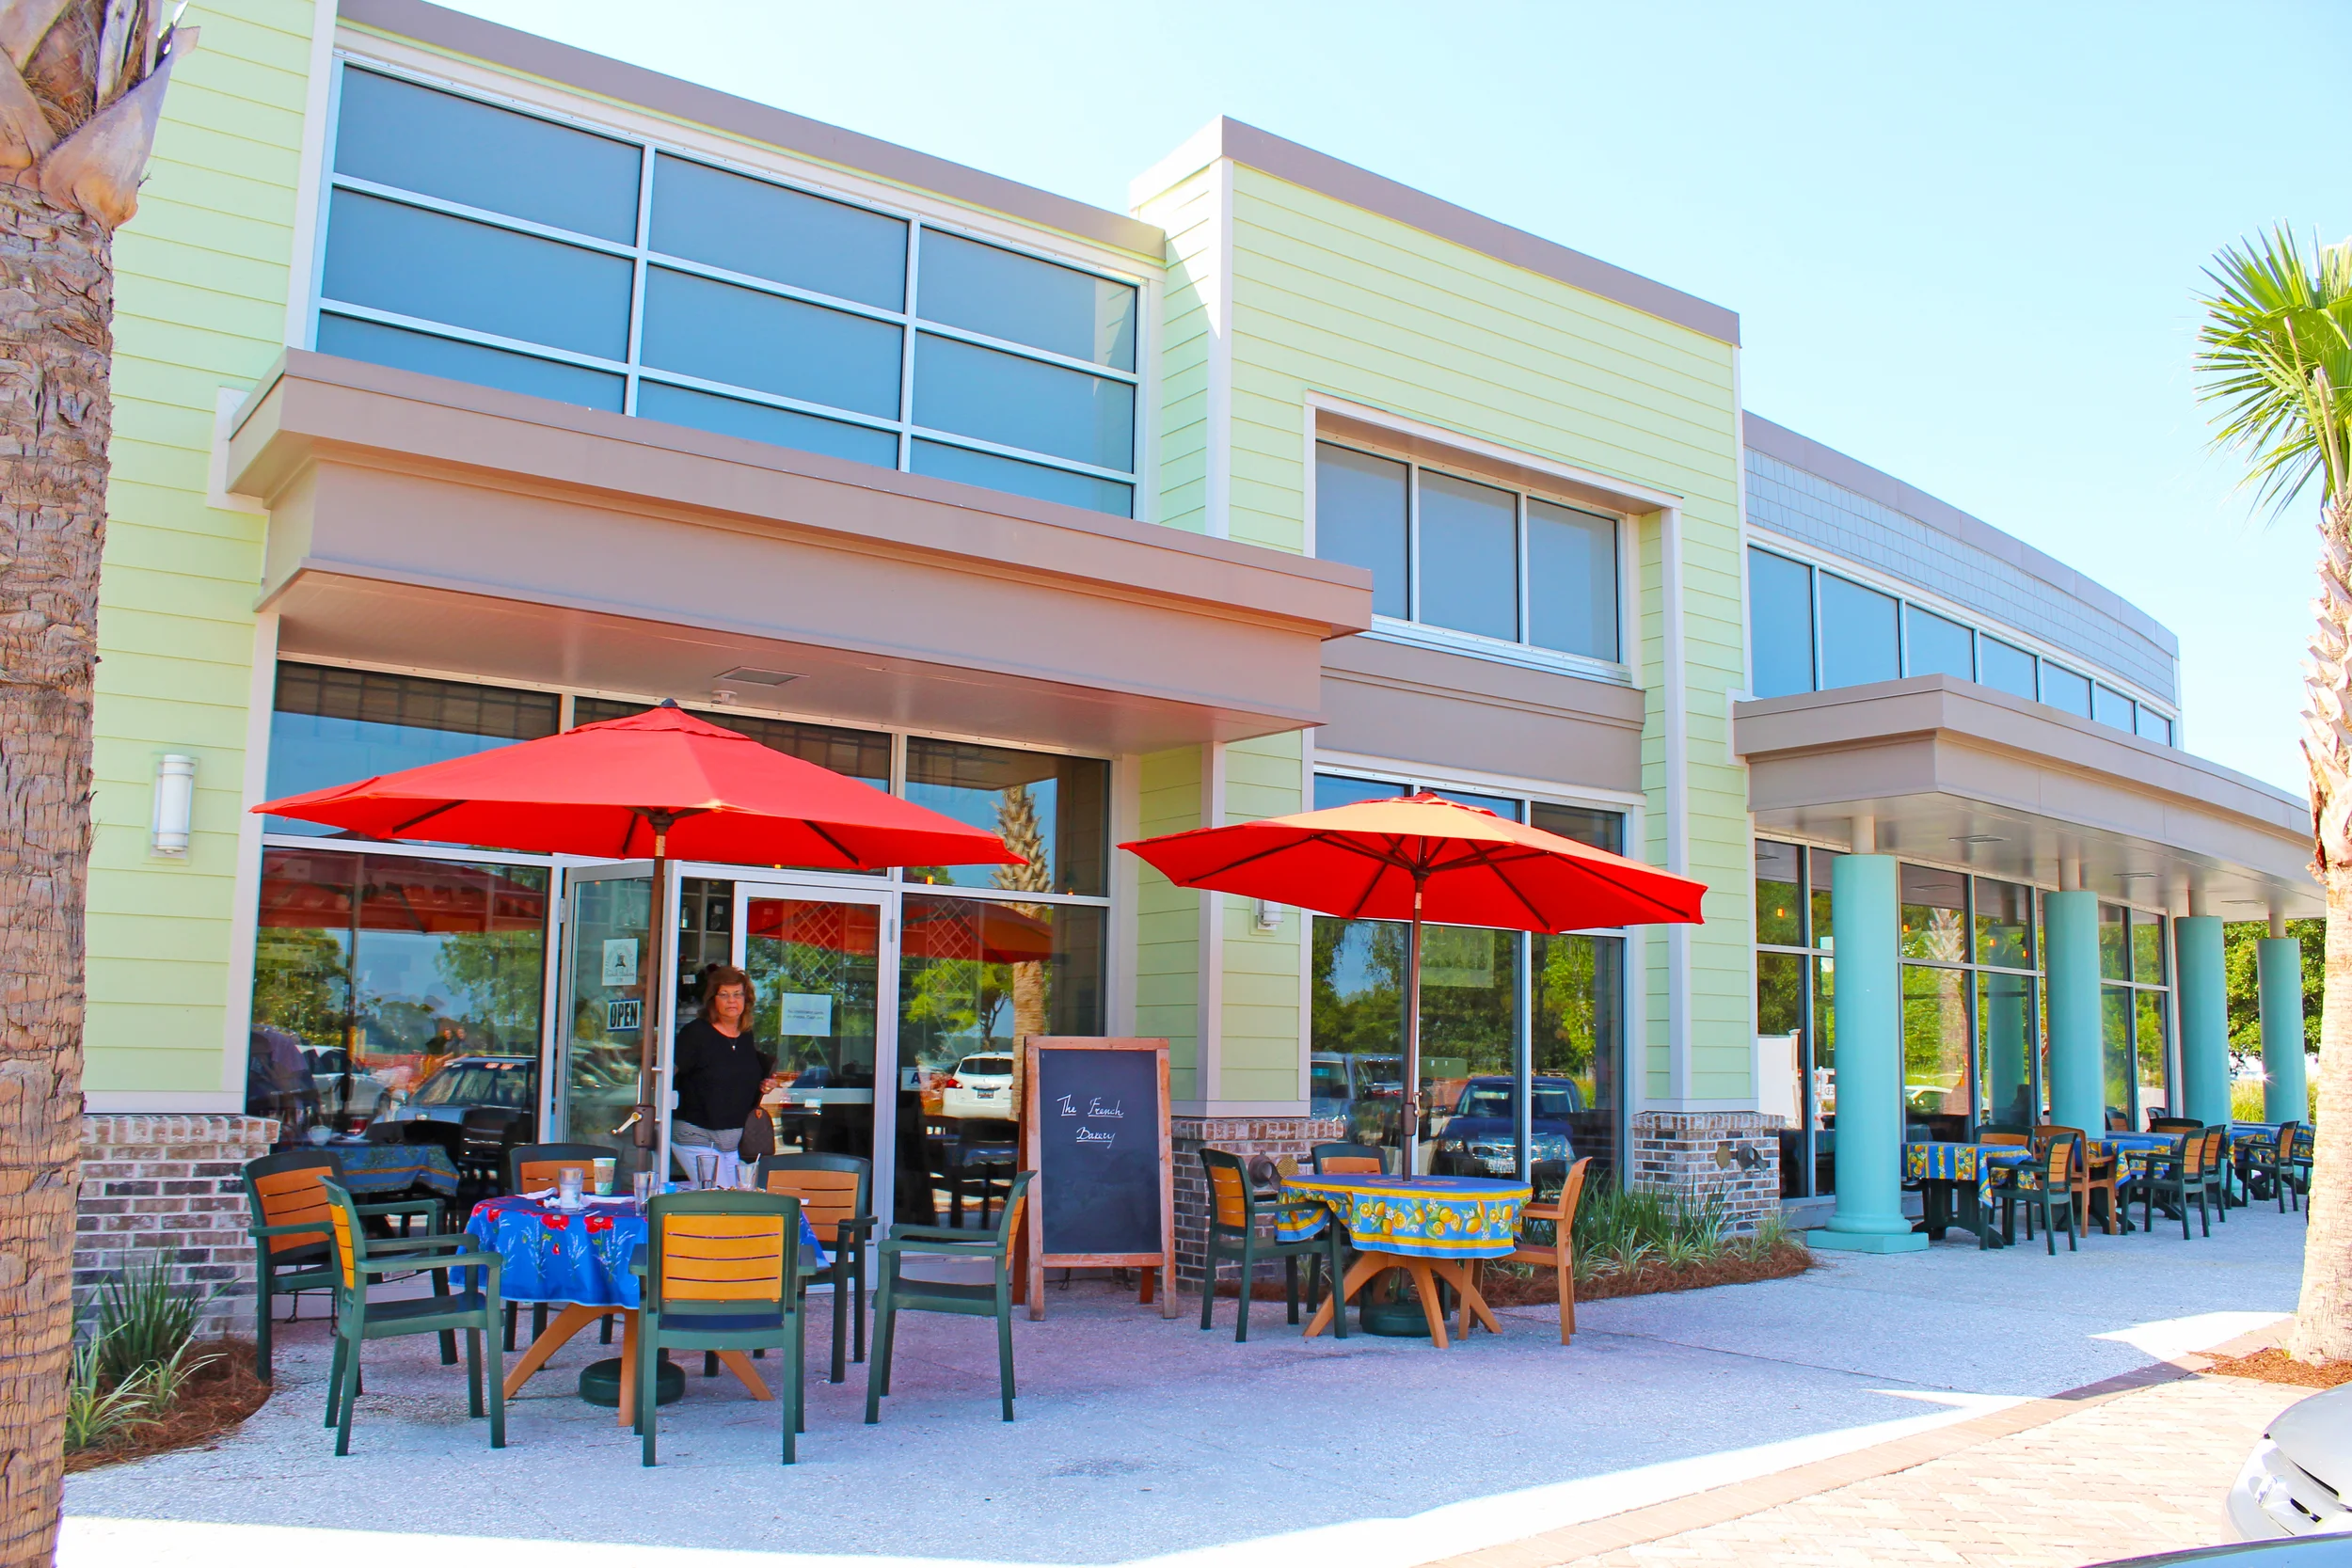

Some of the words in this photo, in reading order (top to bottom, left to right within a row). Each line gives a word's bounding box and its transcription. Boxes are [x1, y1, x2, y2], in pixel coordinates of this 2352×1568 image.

[610, 1002, 638, 1027] OPEN
[910, 1071, 922, 1085] A
[1057, 1094, 1077, 1116] The
[1088, 1097, 1124, 1117] French
[1076, 1127, 1116, 1148] Bakery
